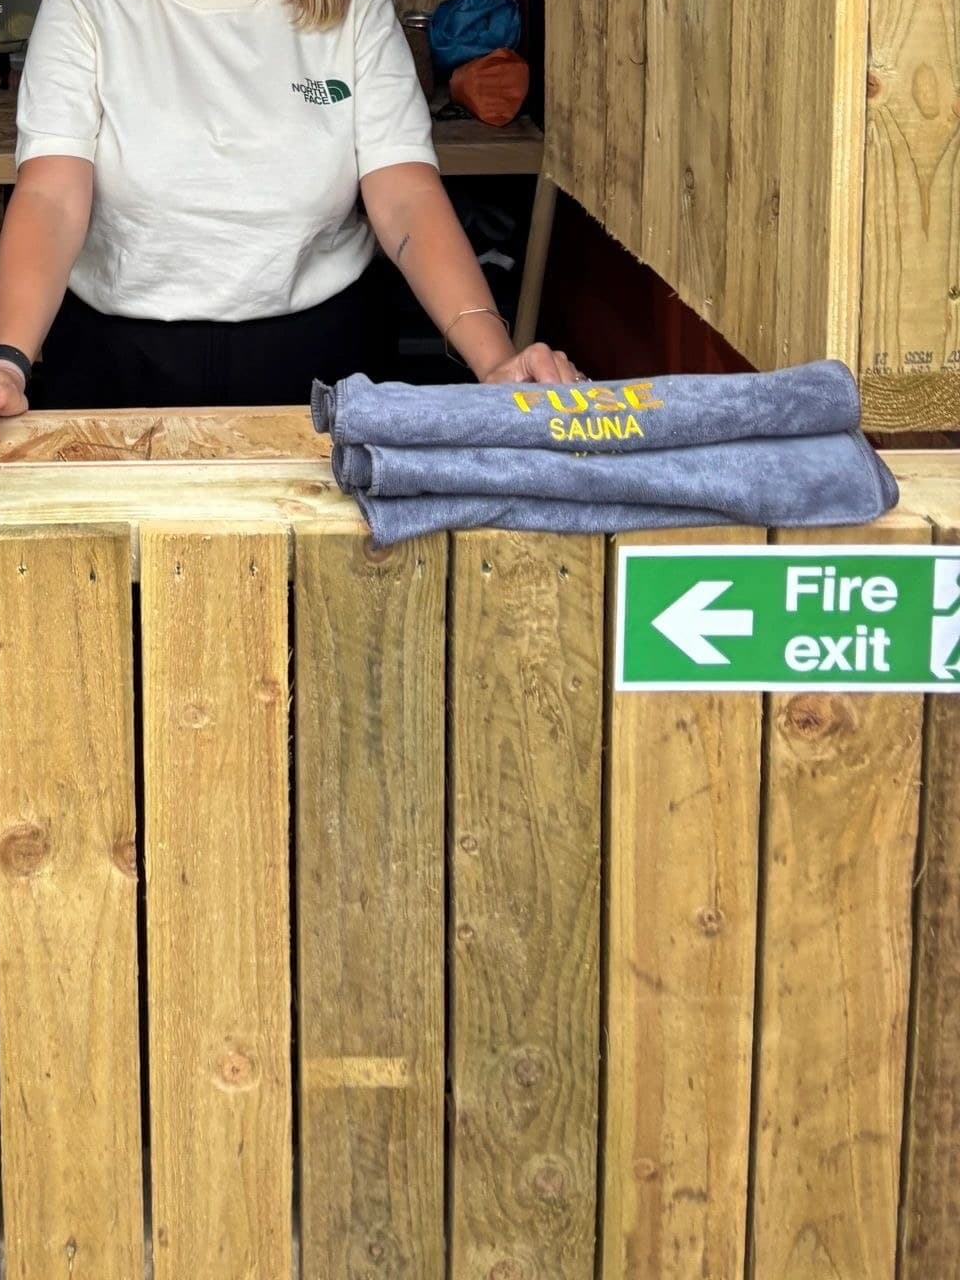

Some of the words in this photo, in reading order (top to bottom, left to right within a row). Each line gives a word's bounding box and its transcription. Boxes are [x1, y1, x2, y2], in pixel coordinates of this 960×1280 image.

[291, 82, 328, 99] NORTH
[304, 77, 324, 89] THE
[303, 94, 331, 106] FACE
[512, 381, 665, 414] FUSE
[548, 413, 645, 442] SAUNA
[785, 565, 899, 613] Fire
[783, 624, 891, 673] exit
